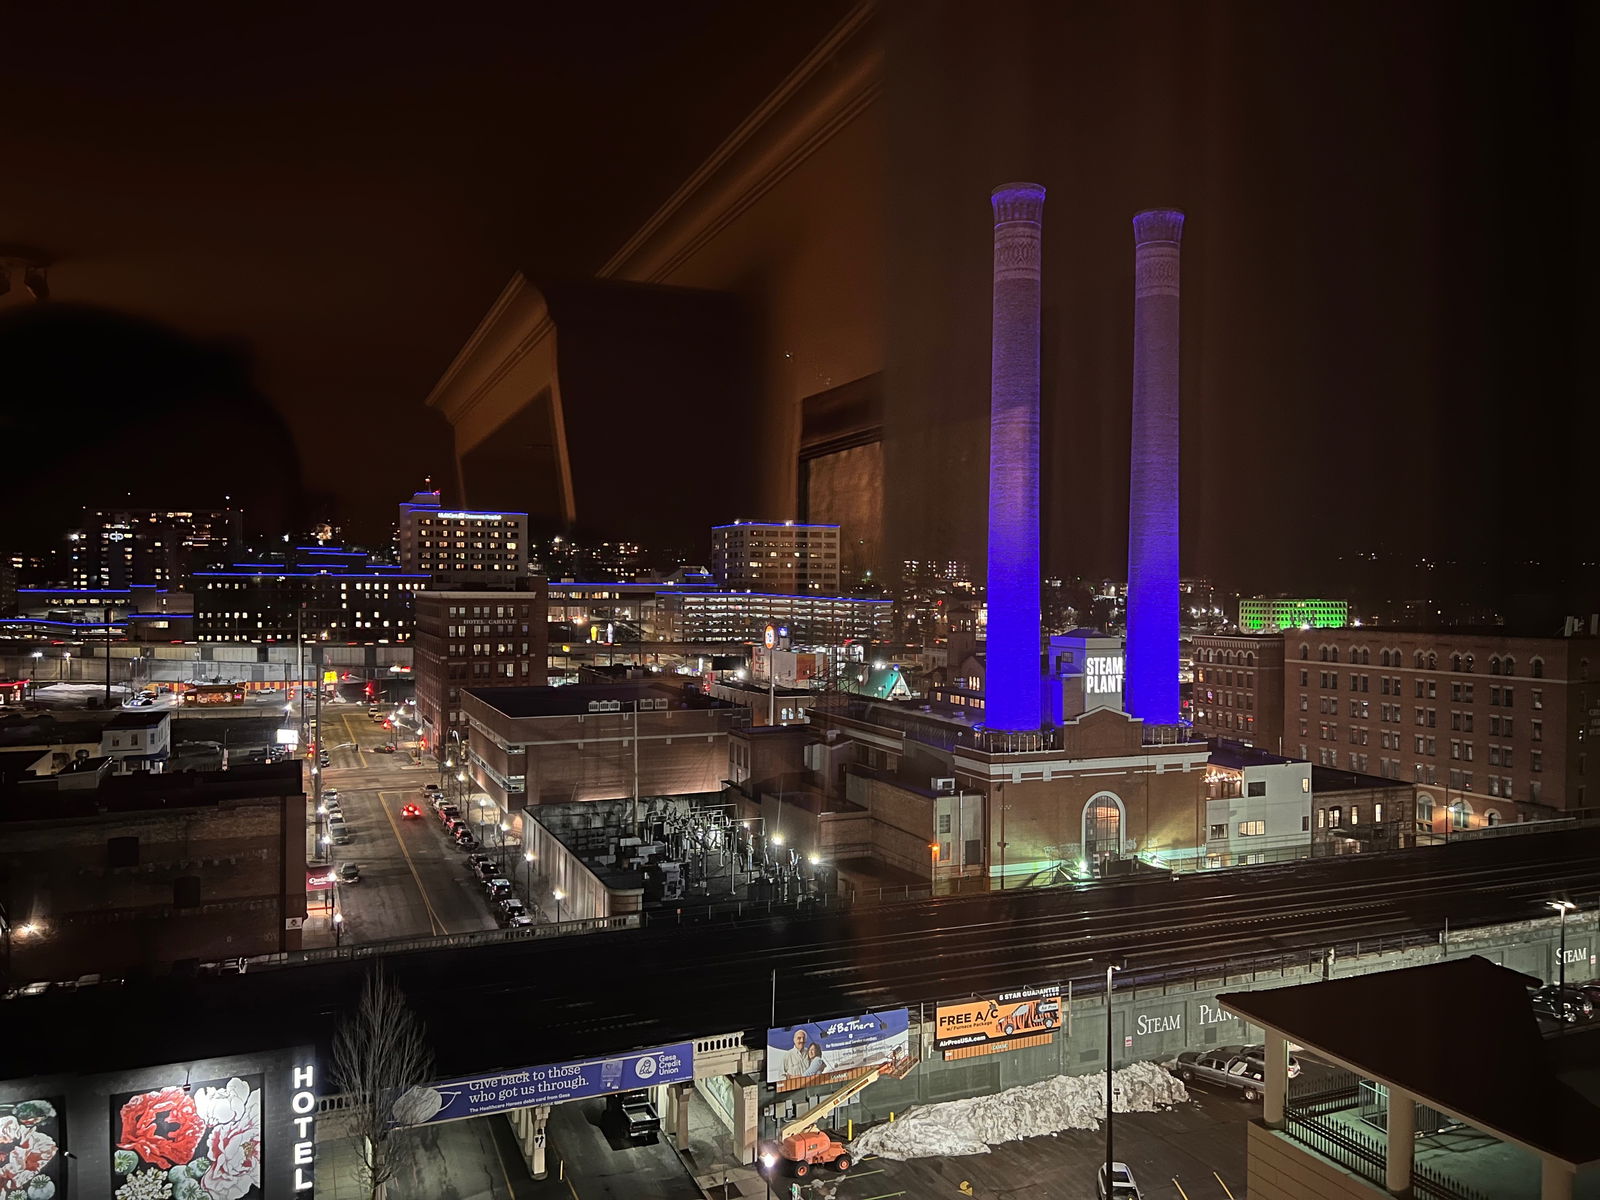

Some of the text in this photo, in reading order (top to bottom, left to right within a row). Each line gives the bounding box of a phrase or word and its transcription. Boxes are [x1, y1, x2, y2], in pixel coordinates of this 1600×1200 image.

[1086, 656, 1123, 675] STEAM
[1086, 674, 1123, 694] PLANT
[1555, 947, 1587, 965] STEAM
[1004, 992, 1022, 1000] STAR
[826, 1019, 875, 1035] #BeThere
[939, 1009, 999, 1027] FREE A/C
[1136, 1004, 1240, 1036] STEAM PLAN
[658, 1054, 677, 1062] Gesa
[658, 1060, 681, 1069] Credit
[469, 1065, 581, 1091] Give back to those
[658, 1067, 679, 1076] Union
[469, 1090, 496, 1104] who
[498, 1086, 518, 1101] got
[521, 1085, 535, 1096] us
[538, 1075, 589, 1093] through.
[292, 1065, 315, 1190] HOTEL
